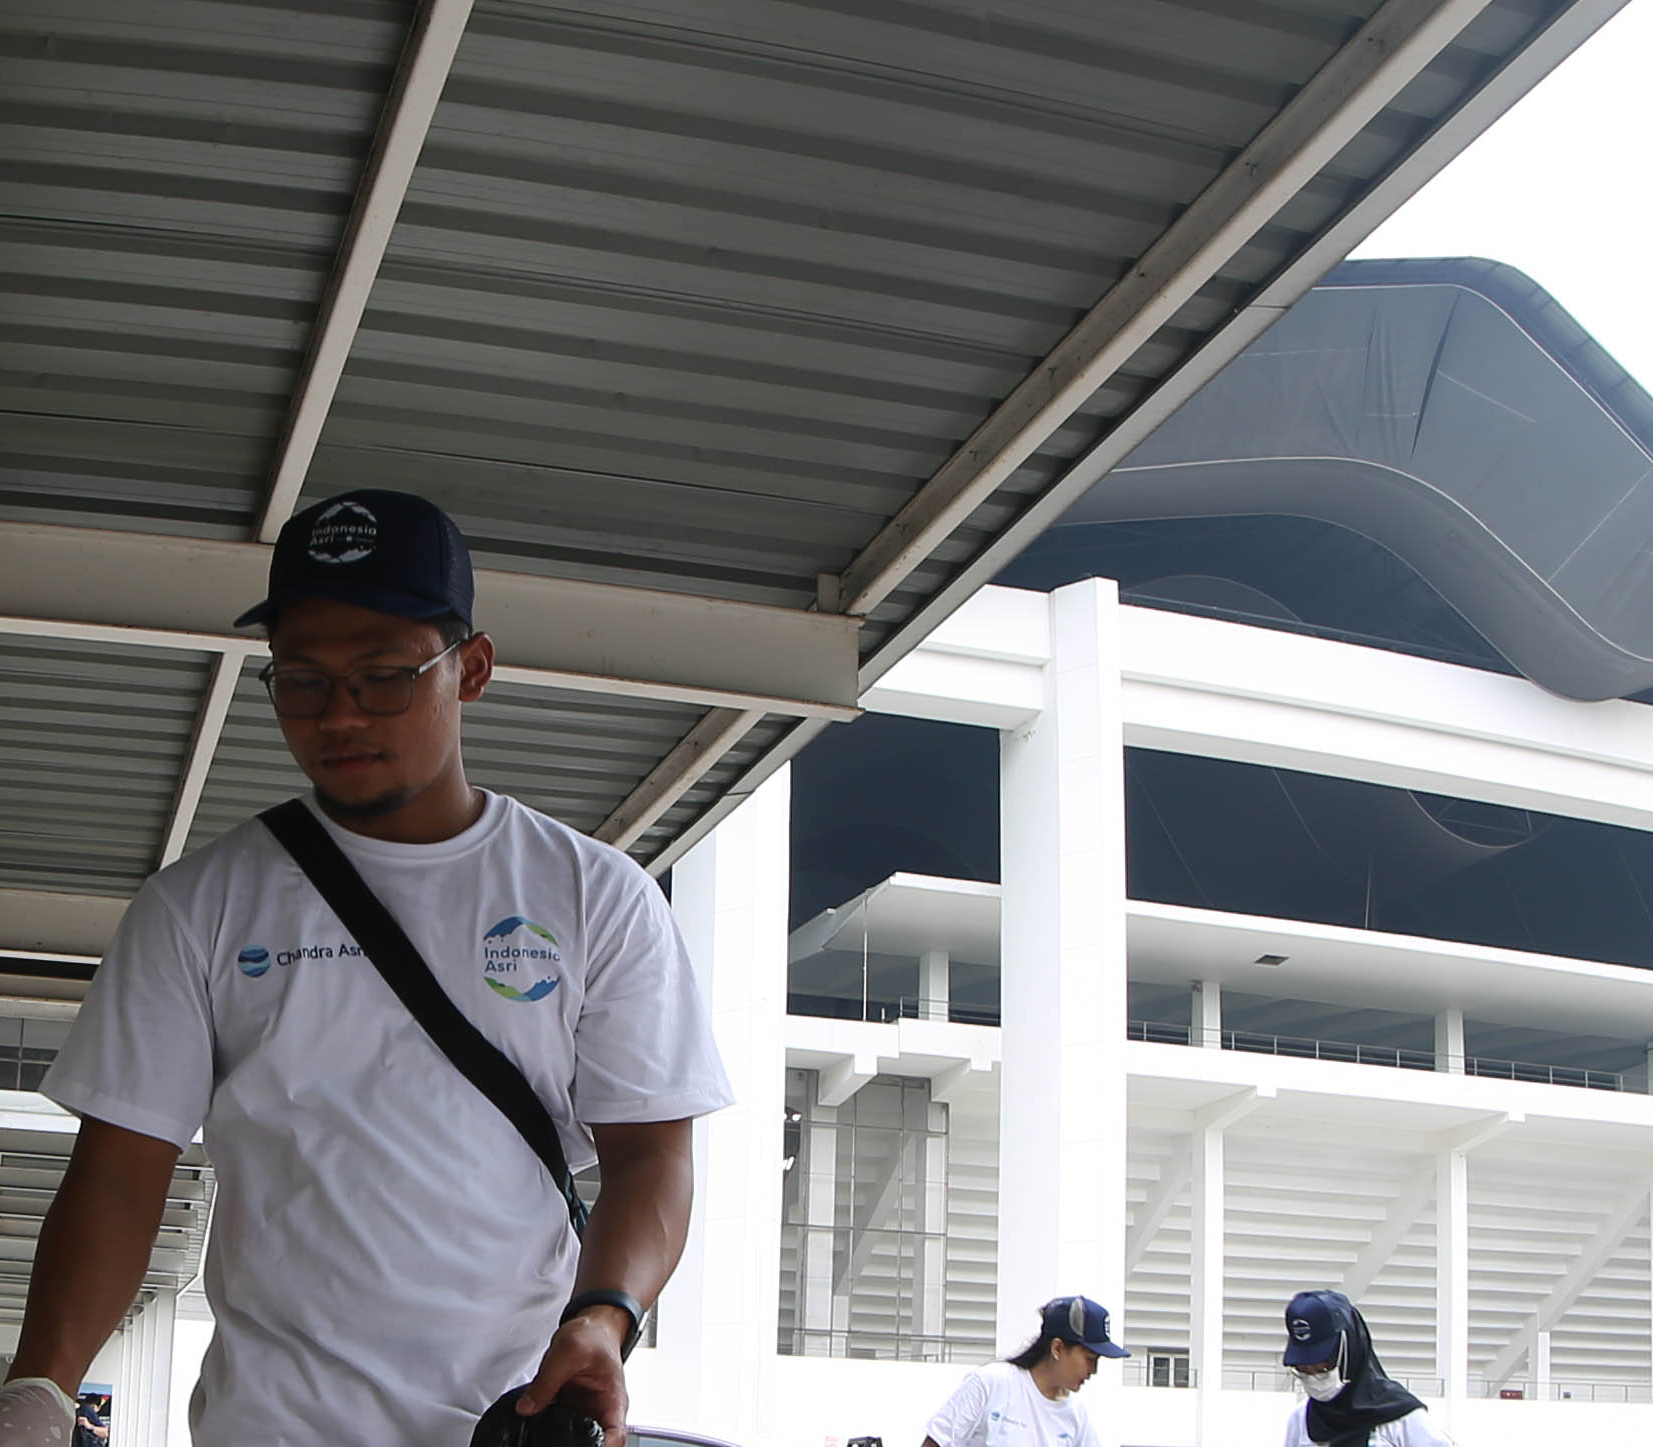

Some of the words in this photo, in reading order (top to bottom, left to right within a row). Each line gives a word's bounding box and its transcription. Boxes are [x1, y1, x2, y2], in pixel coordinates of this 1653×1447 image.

[312, 525, 377, 537] Indonesia
[277, 945, 334, 966] Chandra
[484, 946, 561, 962] Indonesia
[484, 959, 517, 973] Asri
